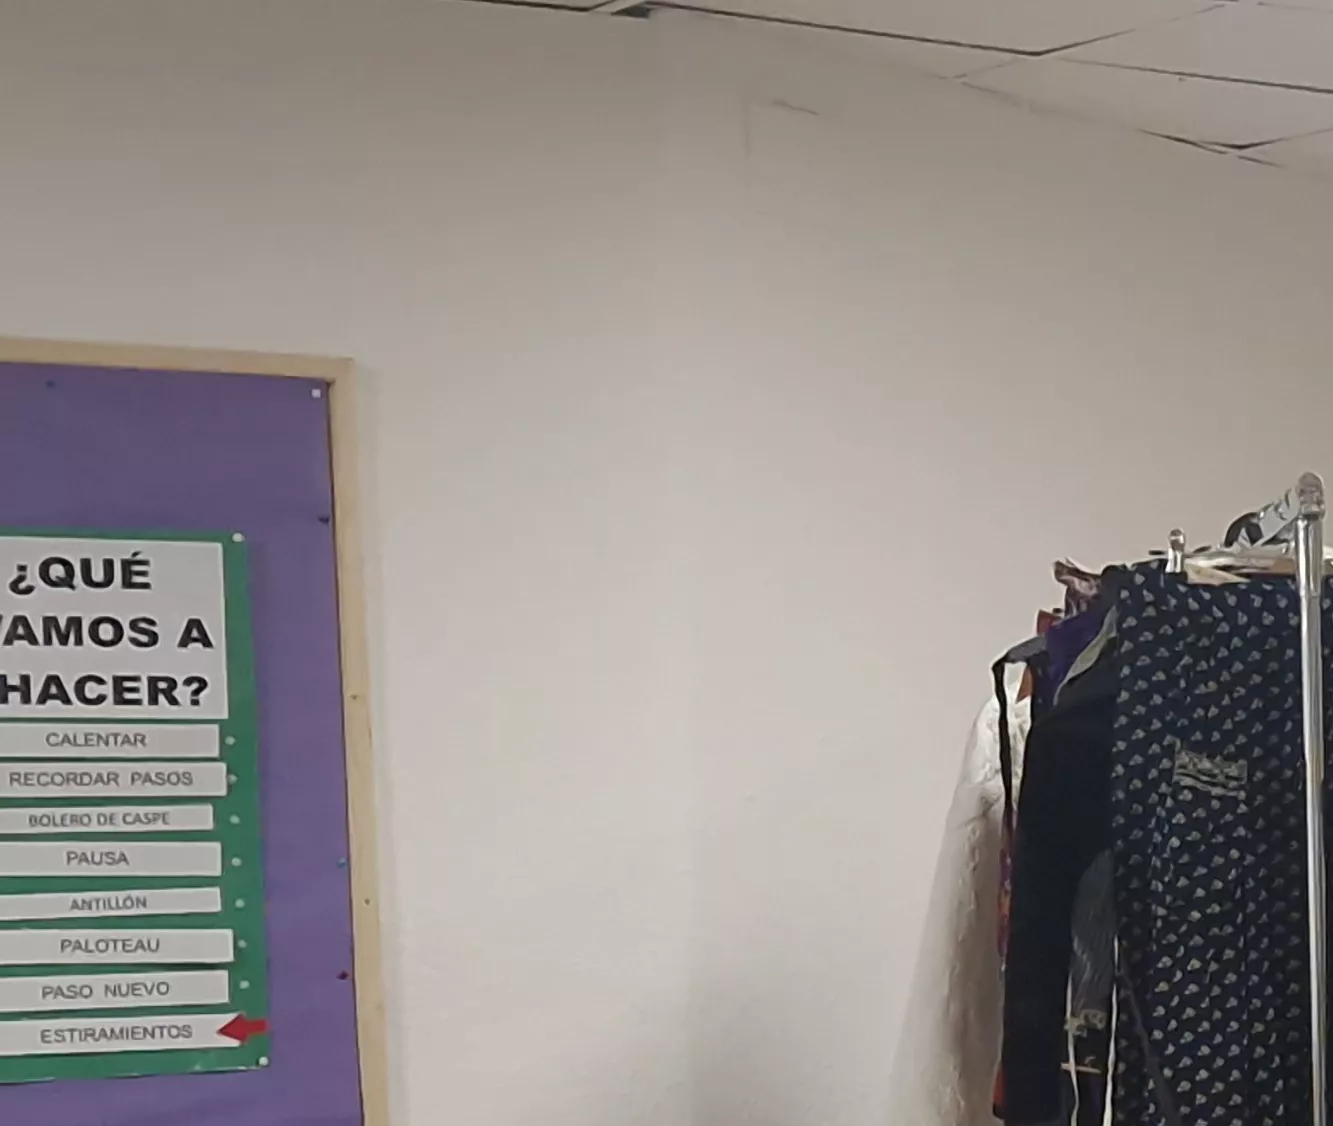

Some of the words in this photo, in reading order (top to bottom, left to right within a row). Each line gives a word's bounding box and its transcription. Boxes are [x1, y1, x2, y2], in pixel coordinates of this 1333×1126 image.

[9, 551, 152, 595] ¿QUÉ
[0, 614, 159, 648] AMOS
[177, 618, 214, 648] A
[0, 674, 208, 706] HACER?
[45, 732, 147, 748] CALENTAR
[9, 771, 120, 787] RECORDAR
[130, 771, 193, 786] PASOS
[29, 813, 91, 827] BOLERO
[97, 813, 117, 826] DE
[122, 811, 170, 825] CASPE
[66, 851, 130, 866] PAUSA
[69, 895, 147, 911] ANTILLÓN
[60, 938, 160, 954] PALOTEAU
[41, 984, 93, 999] PASO
[104, 981, 170, 998] NUEVO
[40, 1024, 193, 1044] ESTIRAMIENTOS
